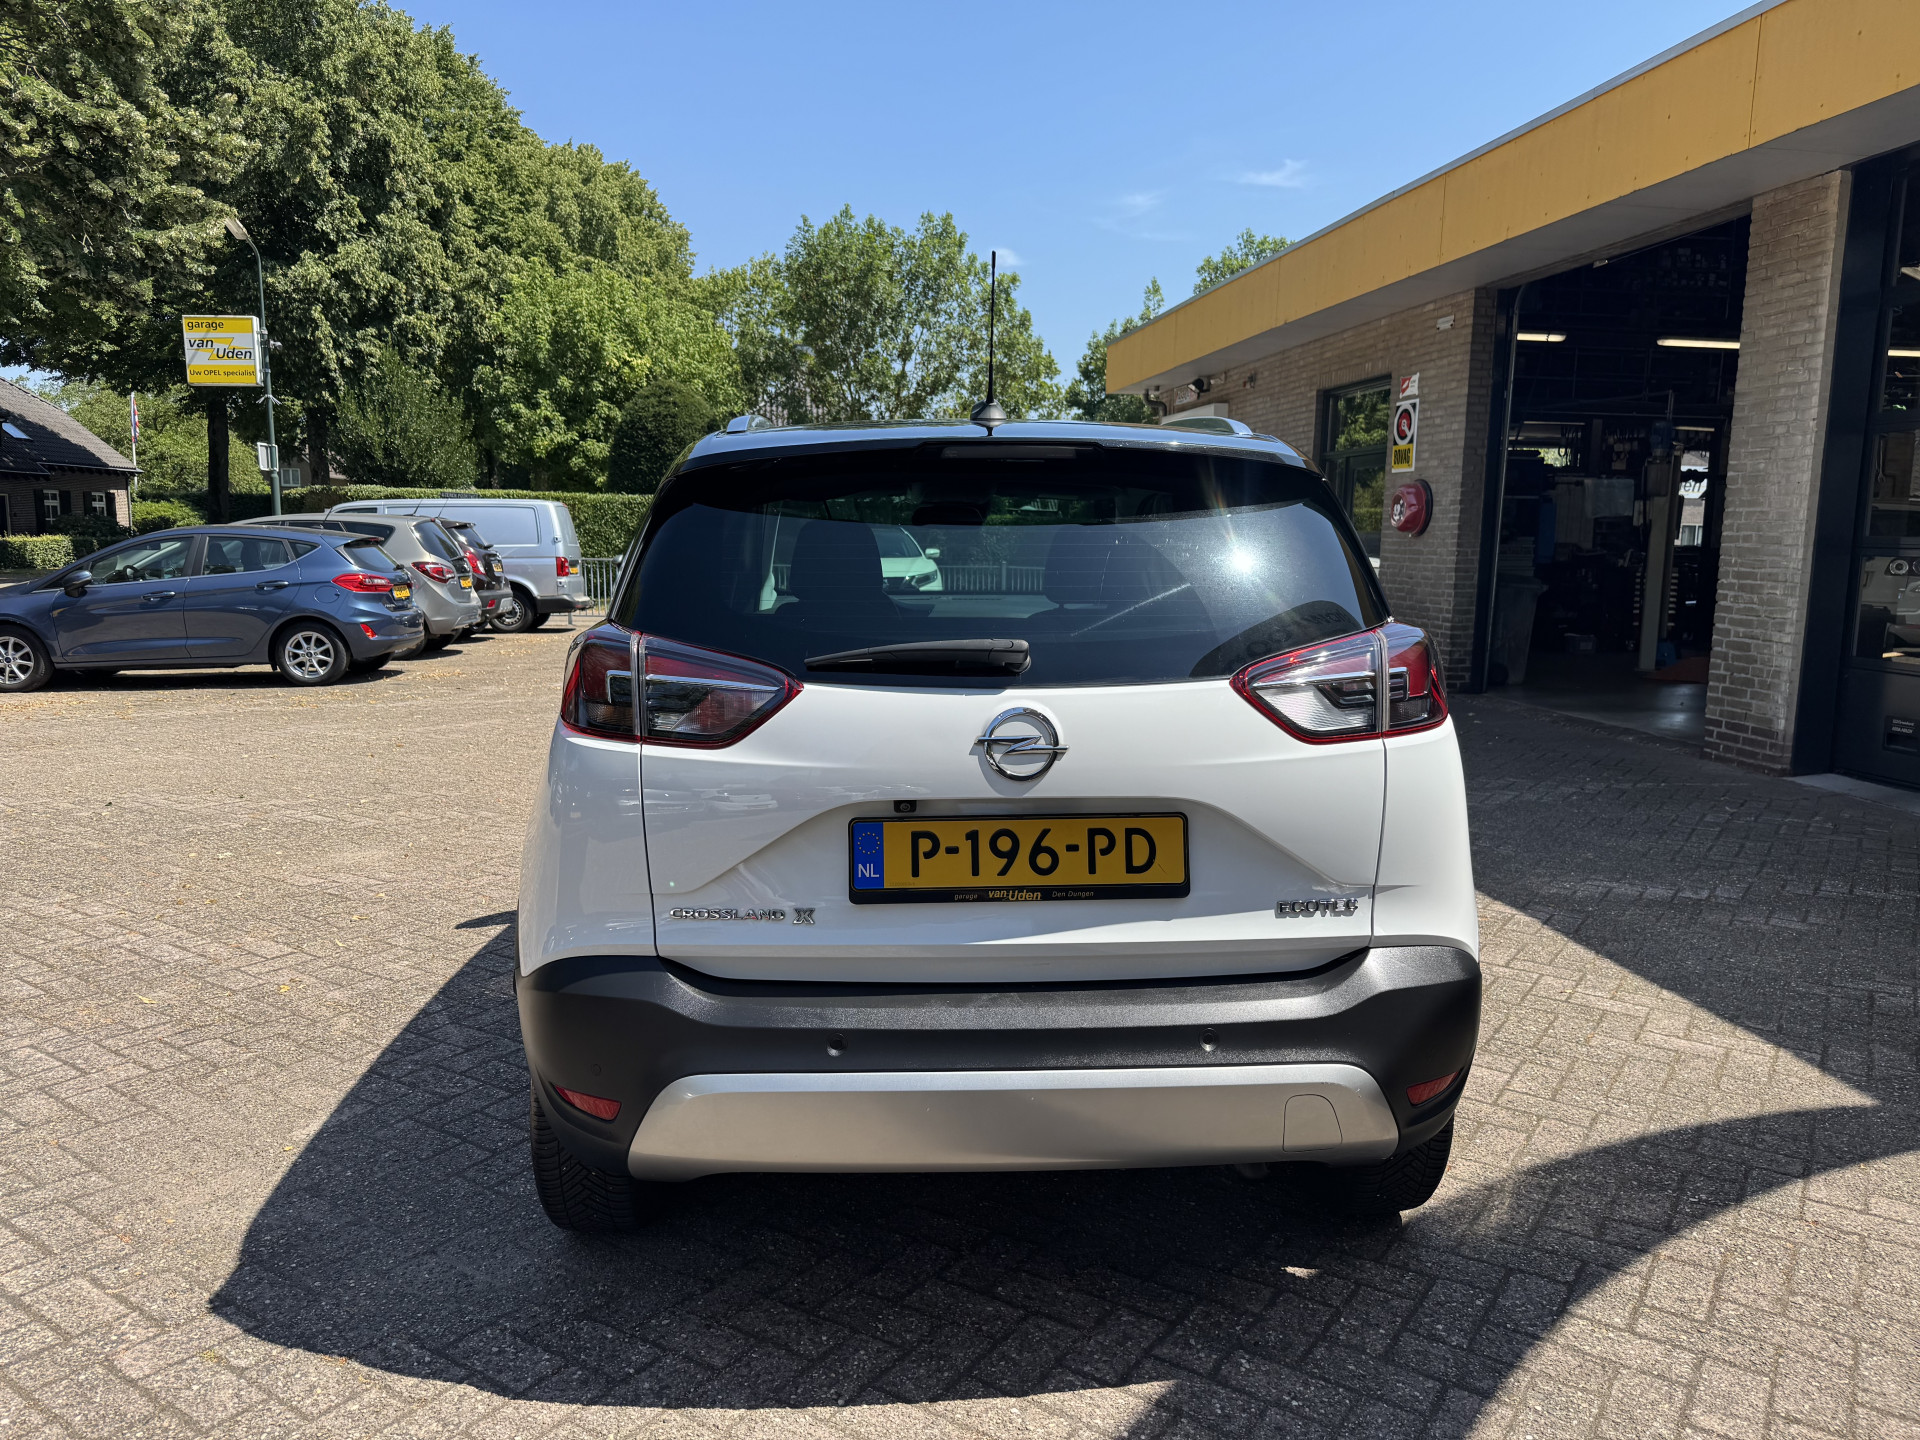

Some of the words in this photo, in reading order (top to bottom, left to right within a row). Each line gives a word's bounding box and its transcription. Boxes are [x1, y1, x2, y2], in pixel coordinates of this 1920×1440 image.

[187, 321, 224, 331] garage
[188, 339, 213, 348] van
[216, 347, 252, 359] Uden
[1393, 448, 1411, 465] BOVAG
[910, 827, 1157, 878] P-196-PD
[857, 863, 880, 878] NL
[954, 893, 978, 901] garage
[988, 888, 1007, 899] van
[1008, 889, 1042, 901] Uden
[1052, 890, 1066, 898] Den
[1068, 889, 1094, 898] Dungen
[1276, 898, 1359, 914] ECOTEC
[669, 908, 786, 921] CROSSLAND
[792, 907, 816, 925] X
